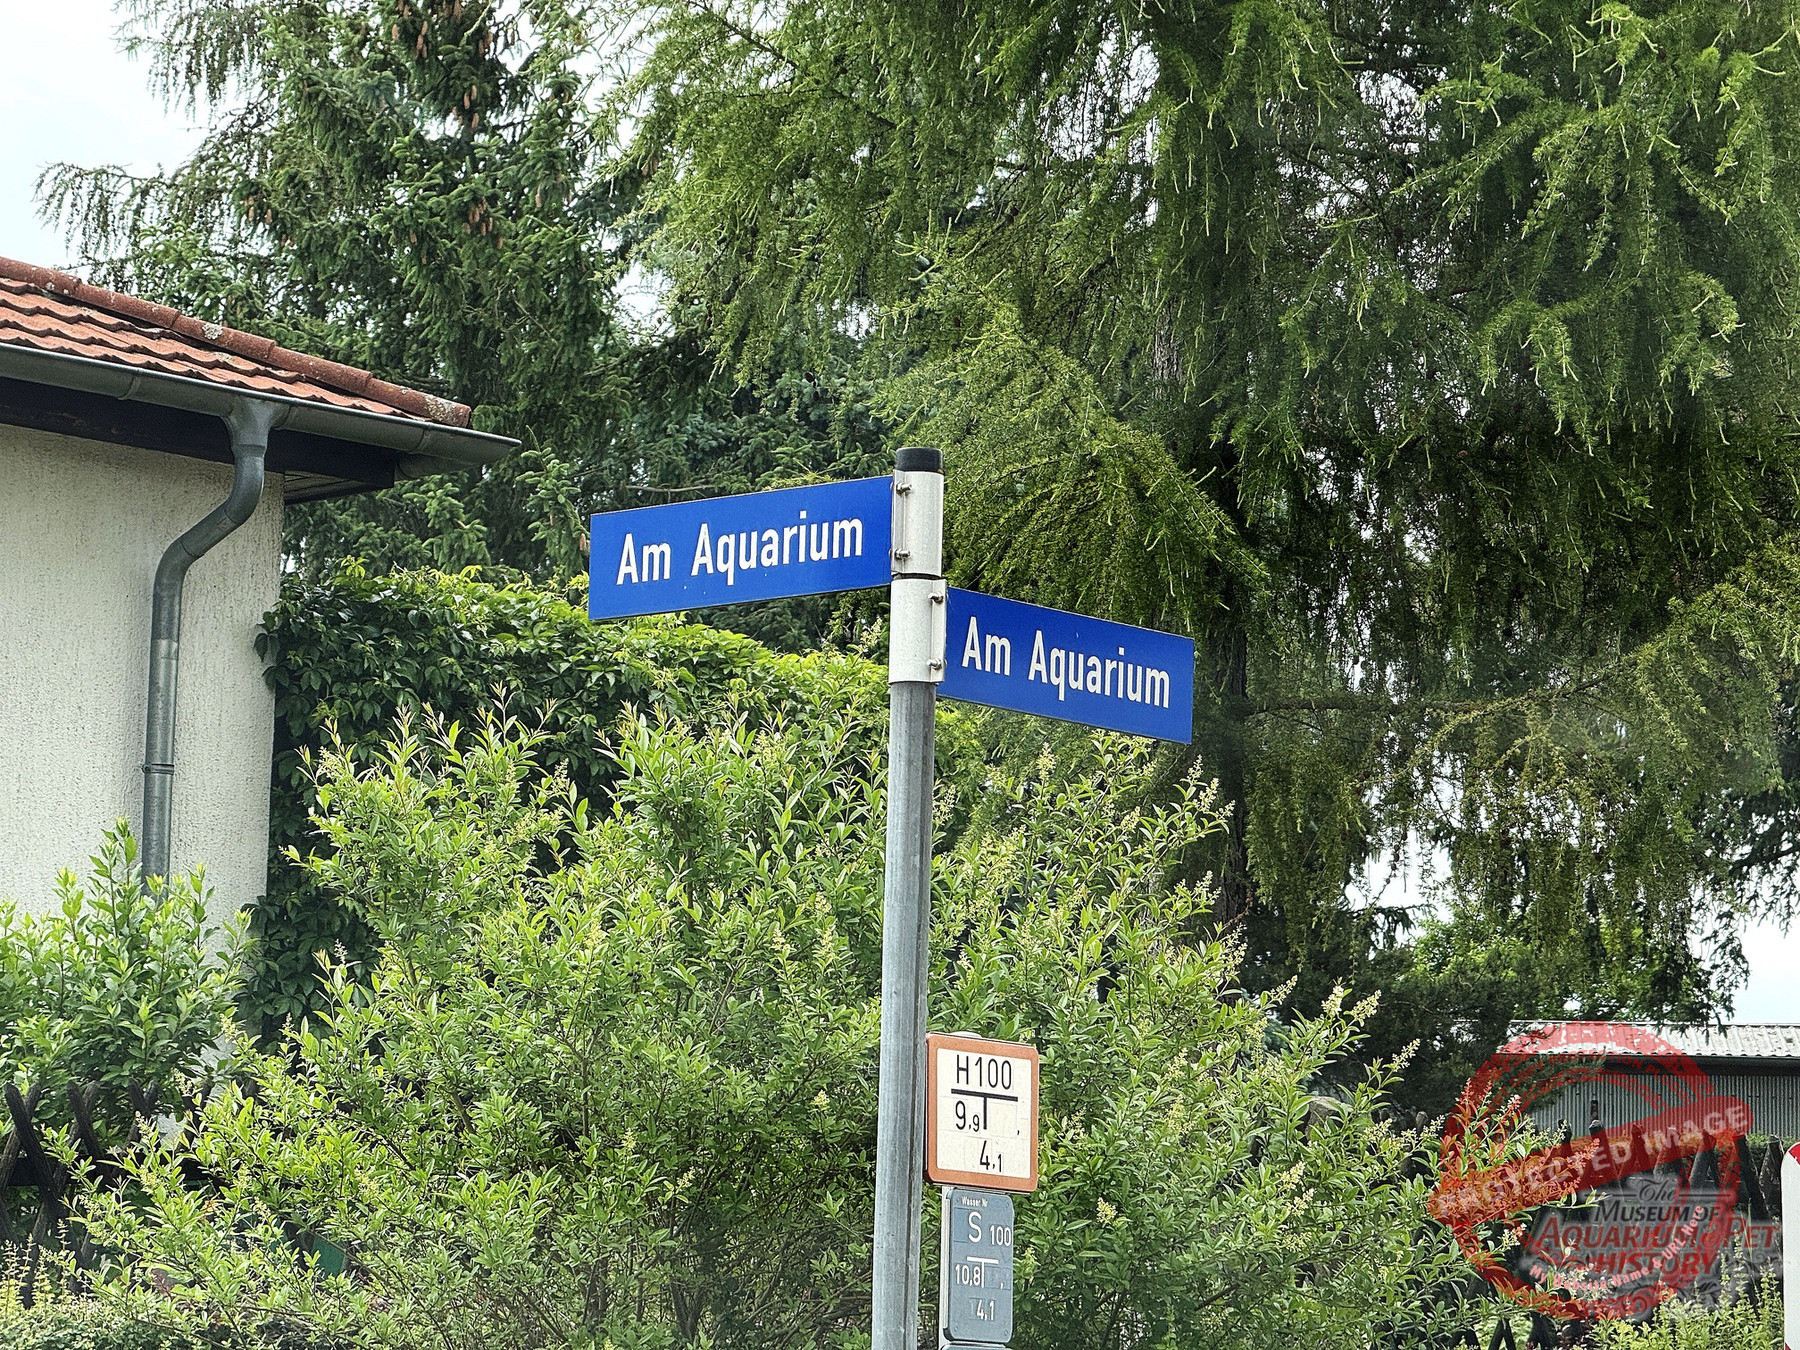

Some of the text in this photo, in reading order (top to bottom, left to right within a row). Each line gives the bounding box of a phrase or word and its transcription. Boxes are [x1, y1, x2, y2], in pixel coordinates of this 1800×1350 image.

[617, 511, 864, 586] Am Aquarium
[962, 616, 1172, 709] Am Aquarium
[956, 1055, 1012, 1090] H100
[979, 1140, 1002, 1173] 4,1
[968, 1211, 1012, 1247] S 100
